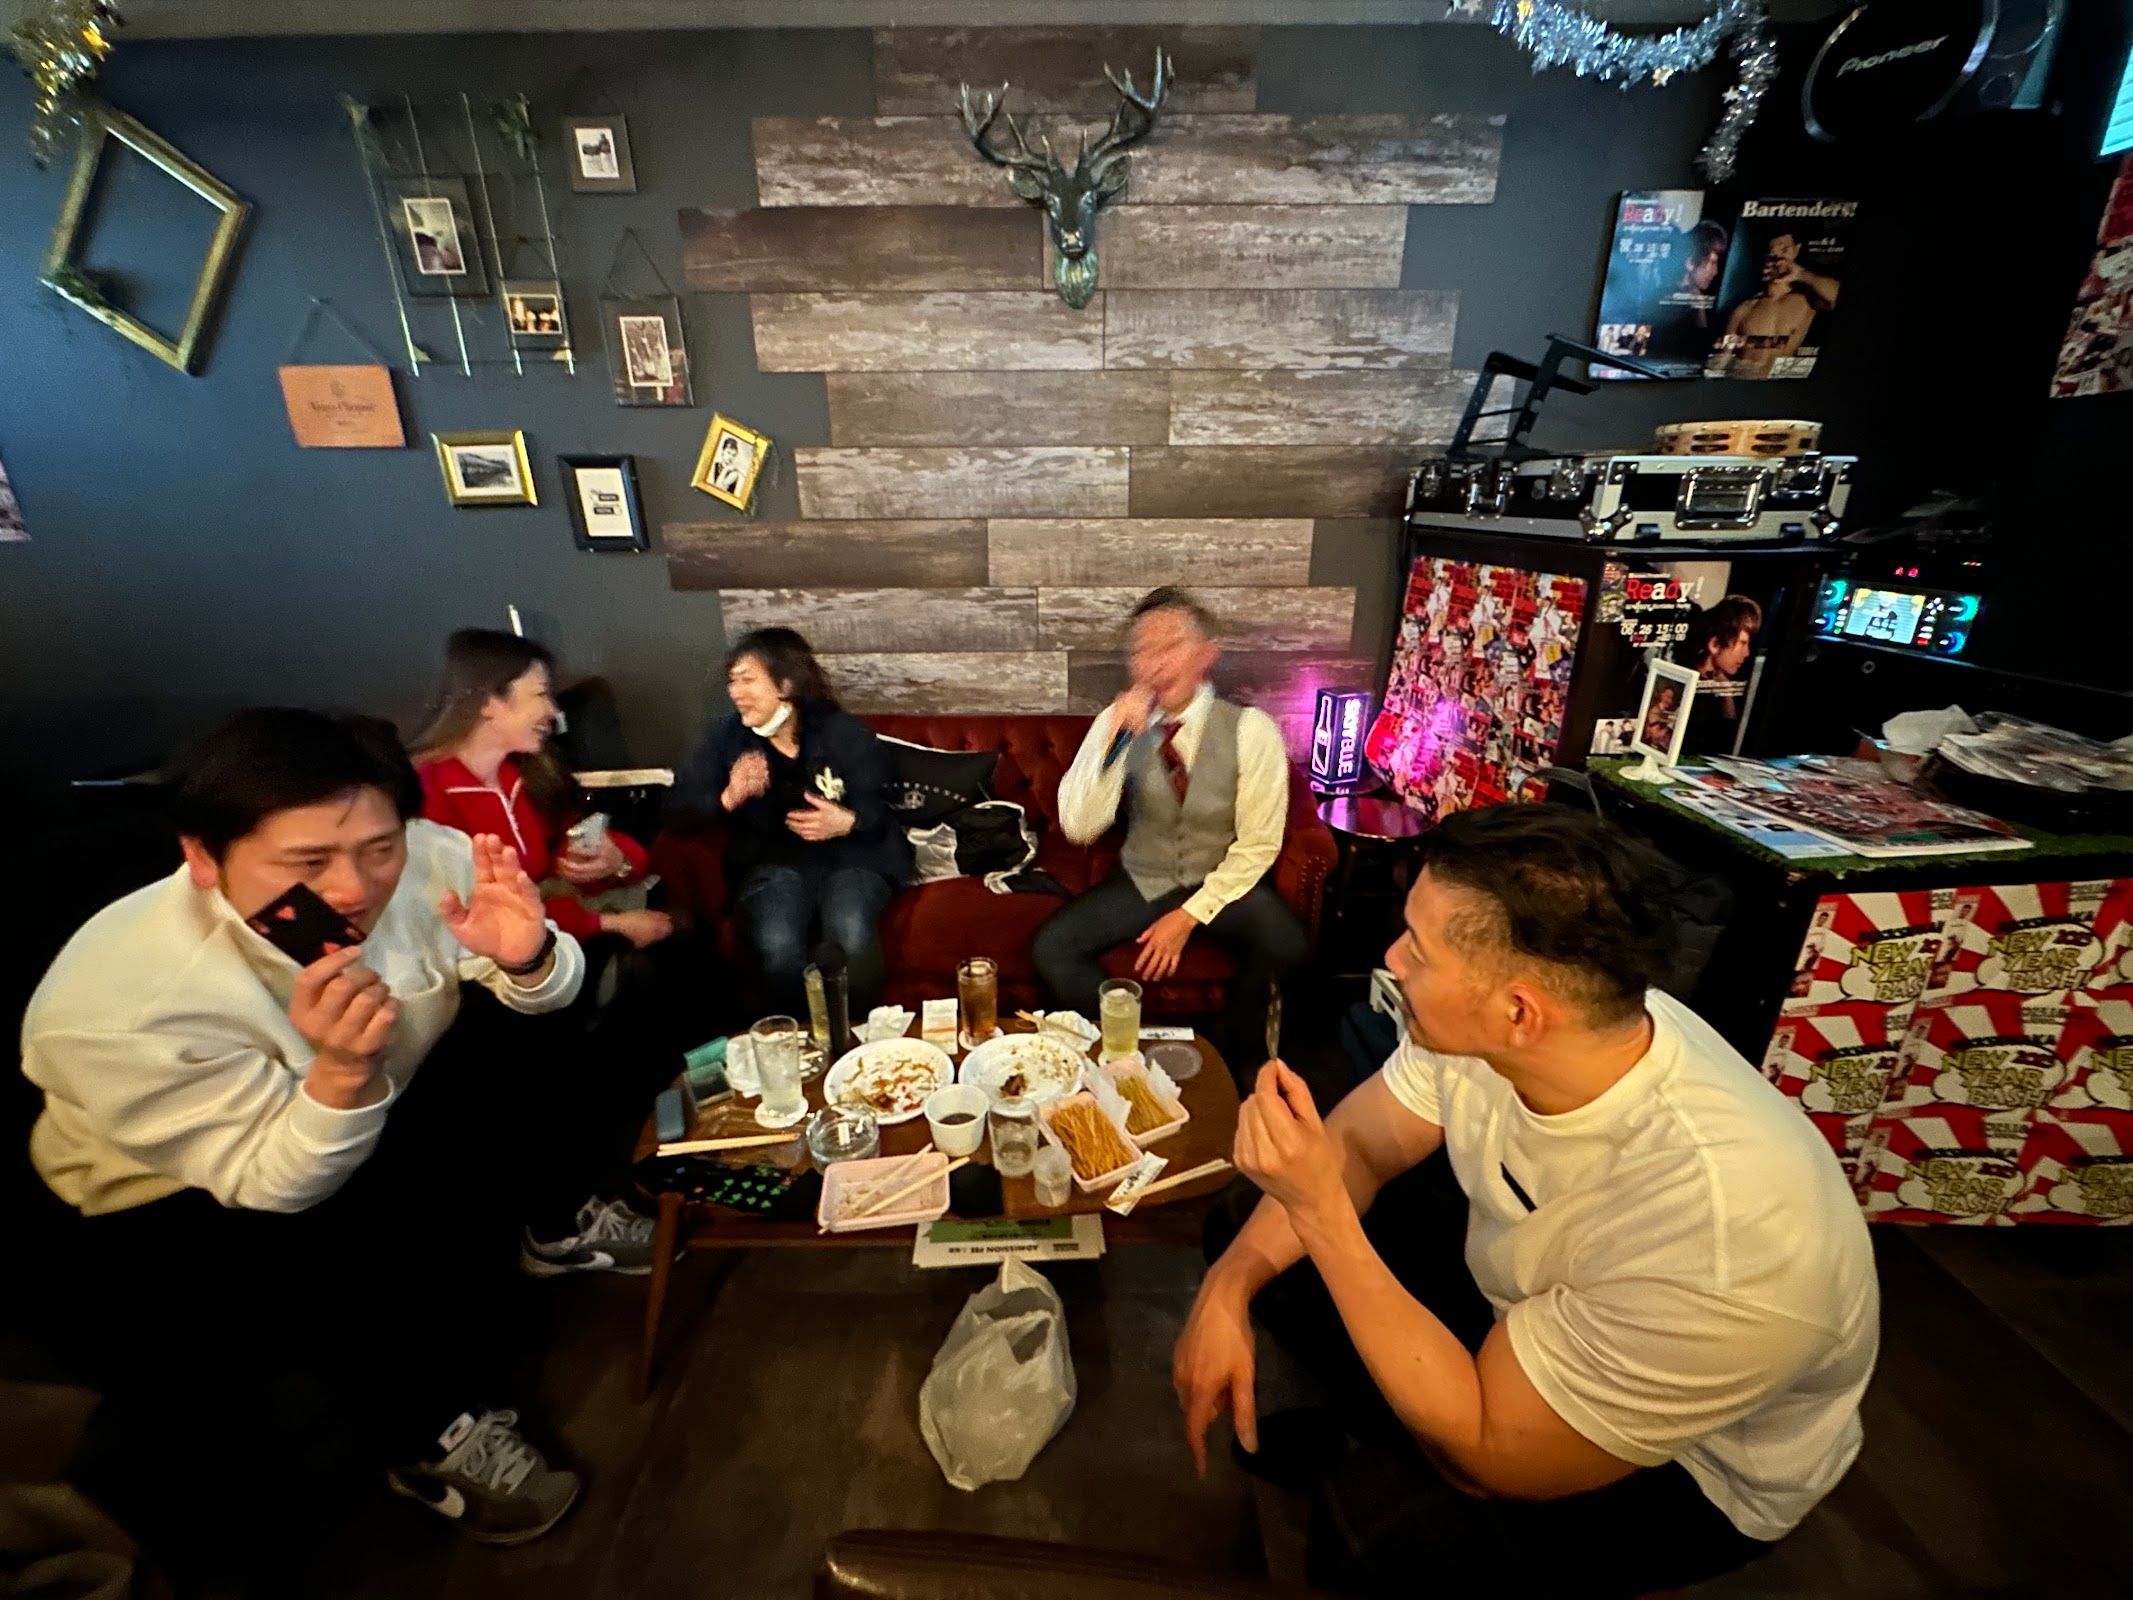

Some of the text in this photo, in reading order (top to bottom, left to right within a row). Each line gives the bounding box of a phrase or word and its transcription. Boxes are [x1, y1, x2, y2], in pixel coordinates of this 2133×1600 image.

[1836, 34, 1949, 78] Pioneer
[1622, 203, 1684, 226] Ready!
[1741, 200, 1859, 218] Bartenders!
[1625, 576, 1705, 603] Ready!
[1851, 941, 1918, 967] NEW
[1988, 931, 2052, 958] NEW
[2002, 947, 2082, 972] YEAR
[1809, 1058, 1874, 1084] NEW
[1941, 1050, 2011, 1072] NEW
[1959, 1067, 2044, 1089] YEAR
[1904, 1160, 1975, 1182] NEW
